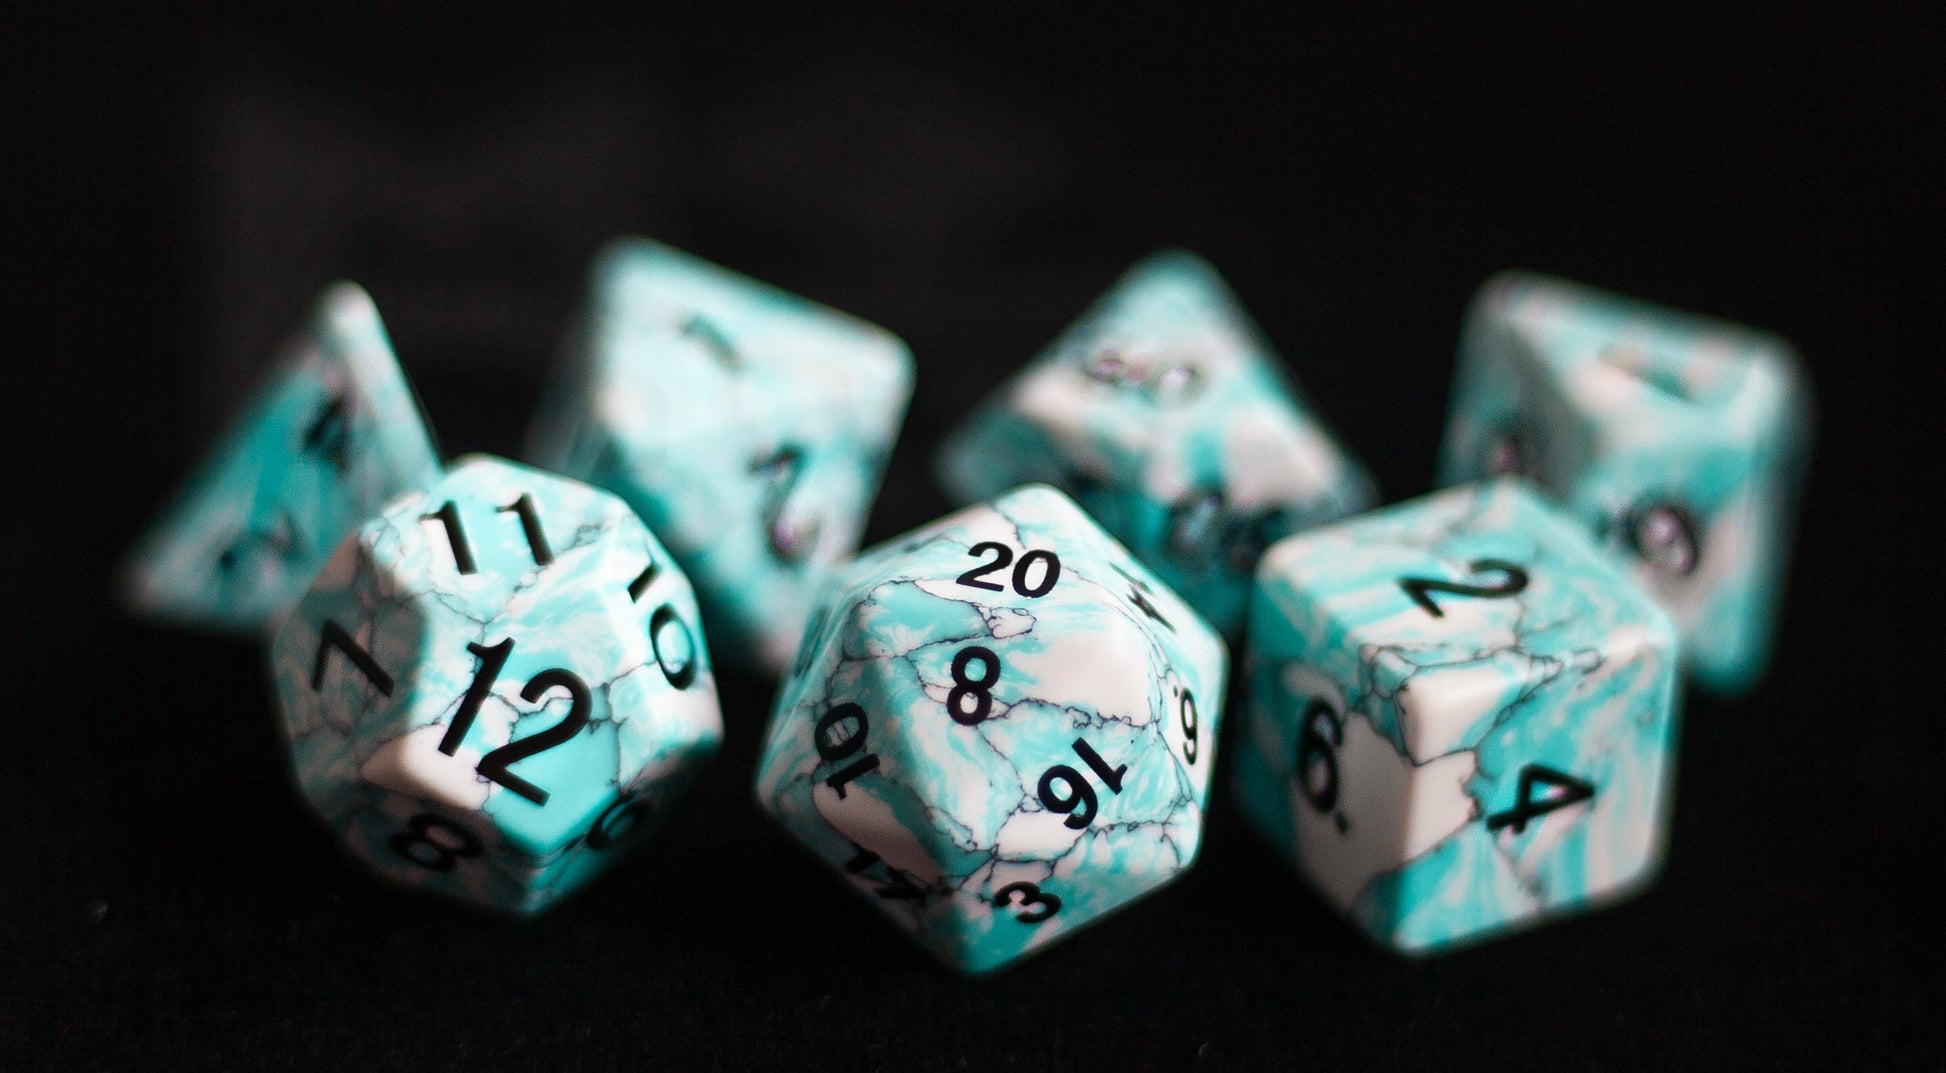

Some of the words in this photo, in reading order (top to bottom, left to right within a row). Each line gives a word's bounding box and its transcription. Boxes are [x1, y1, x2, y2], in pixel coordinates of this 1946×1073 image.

[419, 492, 554, 575] 11
[956, 541, 1061, 599] 20
[1397, 558, 1529, 618] 2
[312, 619, 394, 698] 7
[947, 646, 1000, 726] 8
[437, 637, 592, 807] 12
[814, 702, 881, 800] 10
[1037, 737, 1128, 830] 16
[1486, 764, 1596, 834] 4
[389, 812, 485, 871] 8
[995, 881, 1062, 924] 3
